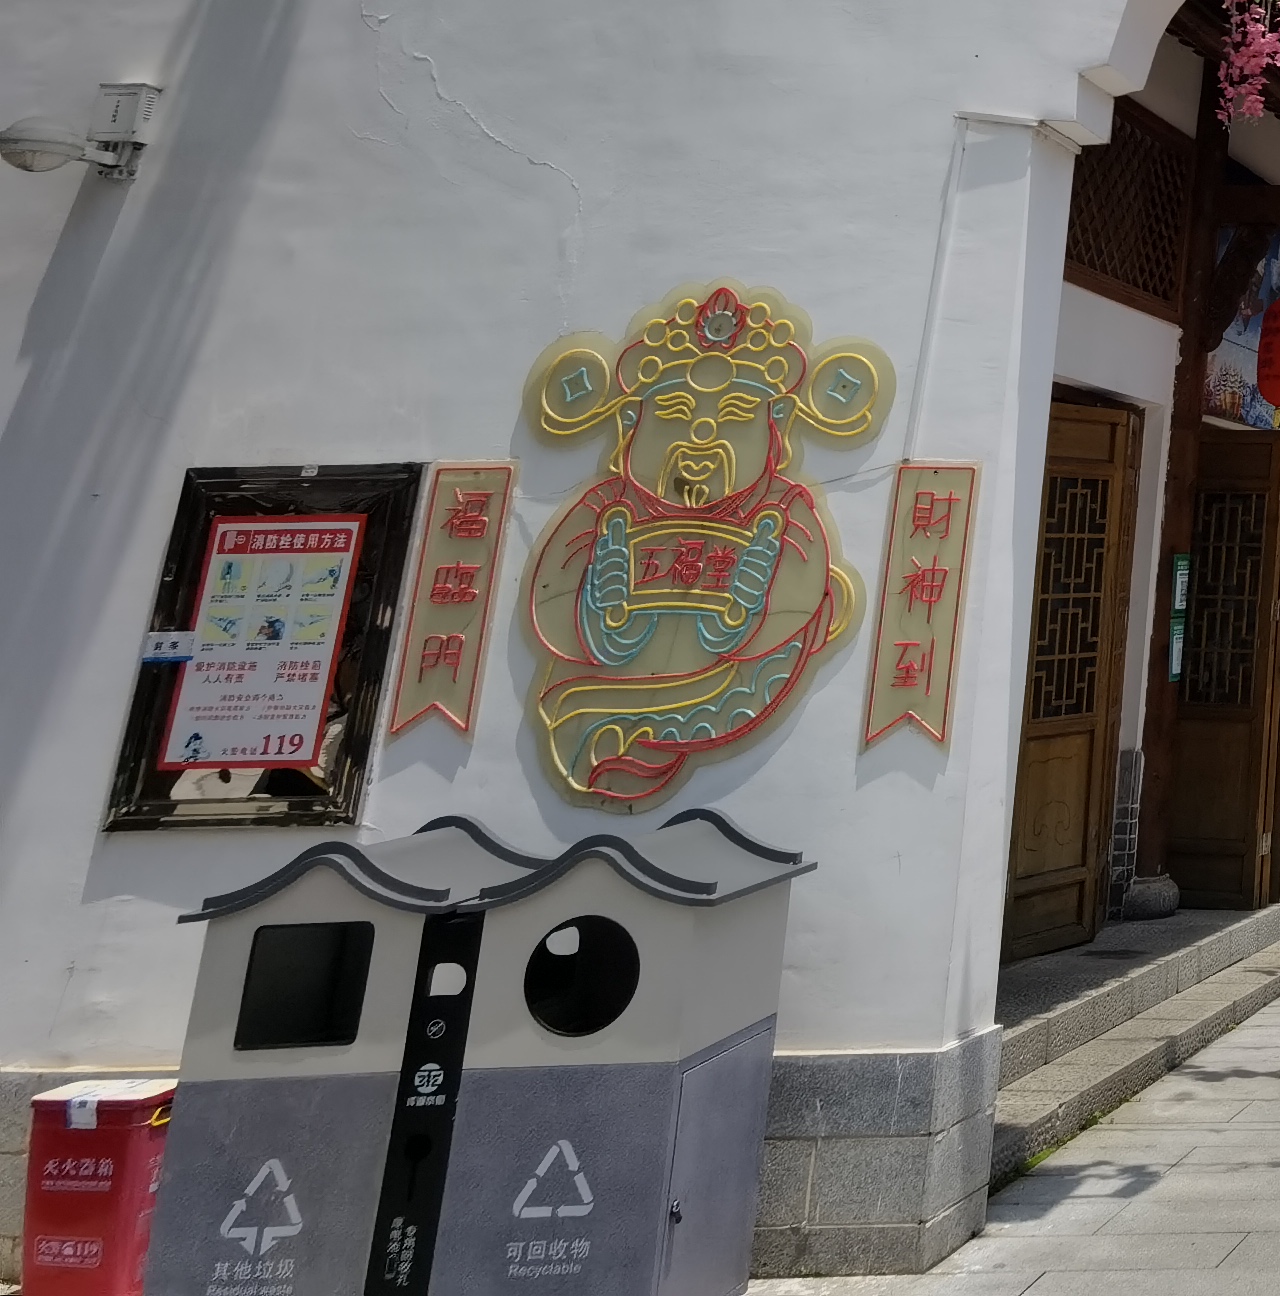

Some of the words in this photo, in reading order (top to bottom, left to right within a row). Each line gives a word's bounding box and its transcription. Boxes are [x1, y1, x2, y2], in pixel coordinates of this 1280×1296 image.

[251, 532, 347, 550] 消防栓使用方法
[635, 537, 737, 591] 五福堂
[893, 490, 960, 696] 財神到
[259, 733, 304, 756] 119
[43, 1157, 114, 1177] 灭火器箱
[506, 1238, 591, 1263] 可回收物
[211, 1259, 296, 1281] 其他垃圾
[508, 1261, 582, 1279] Recyclable
